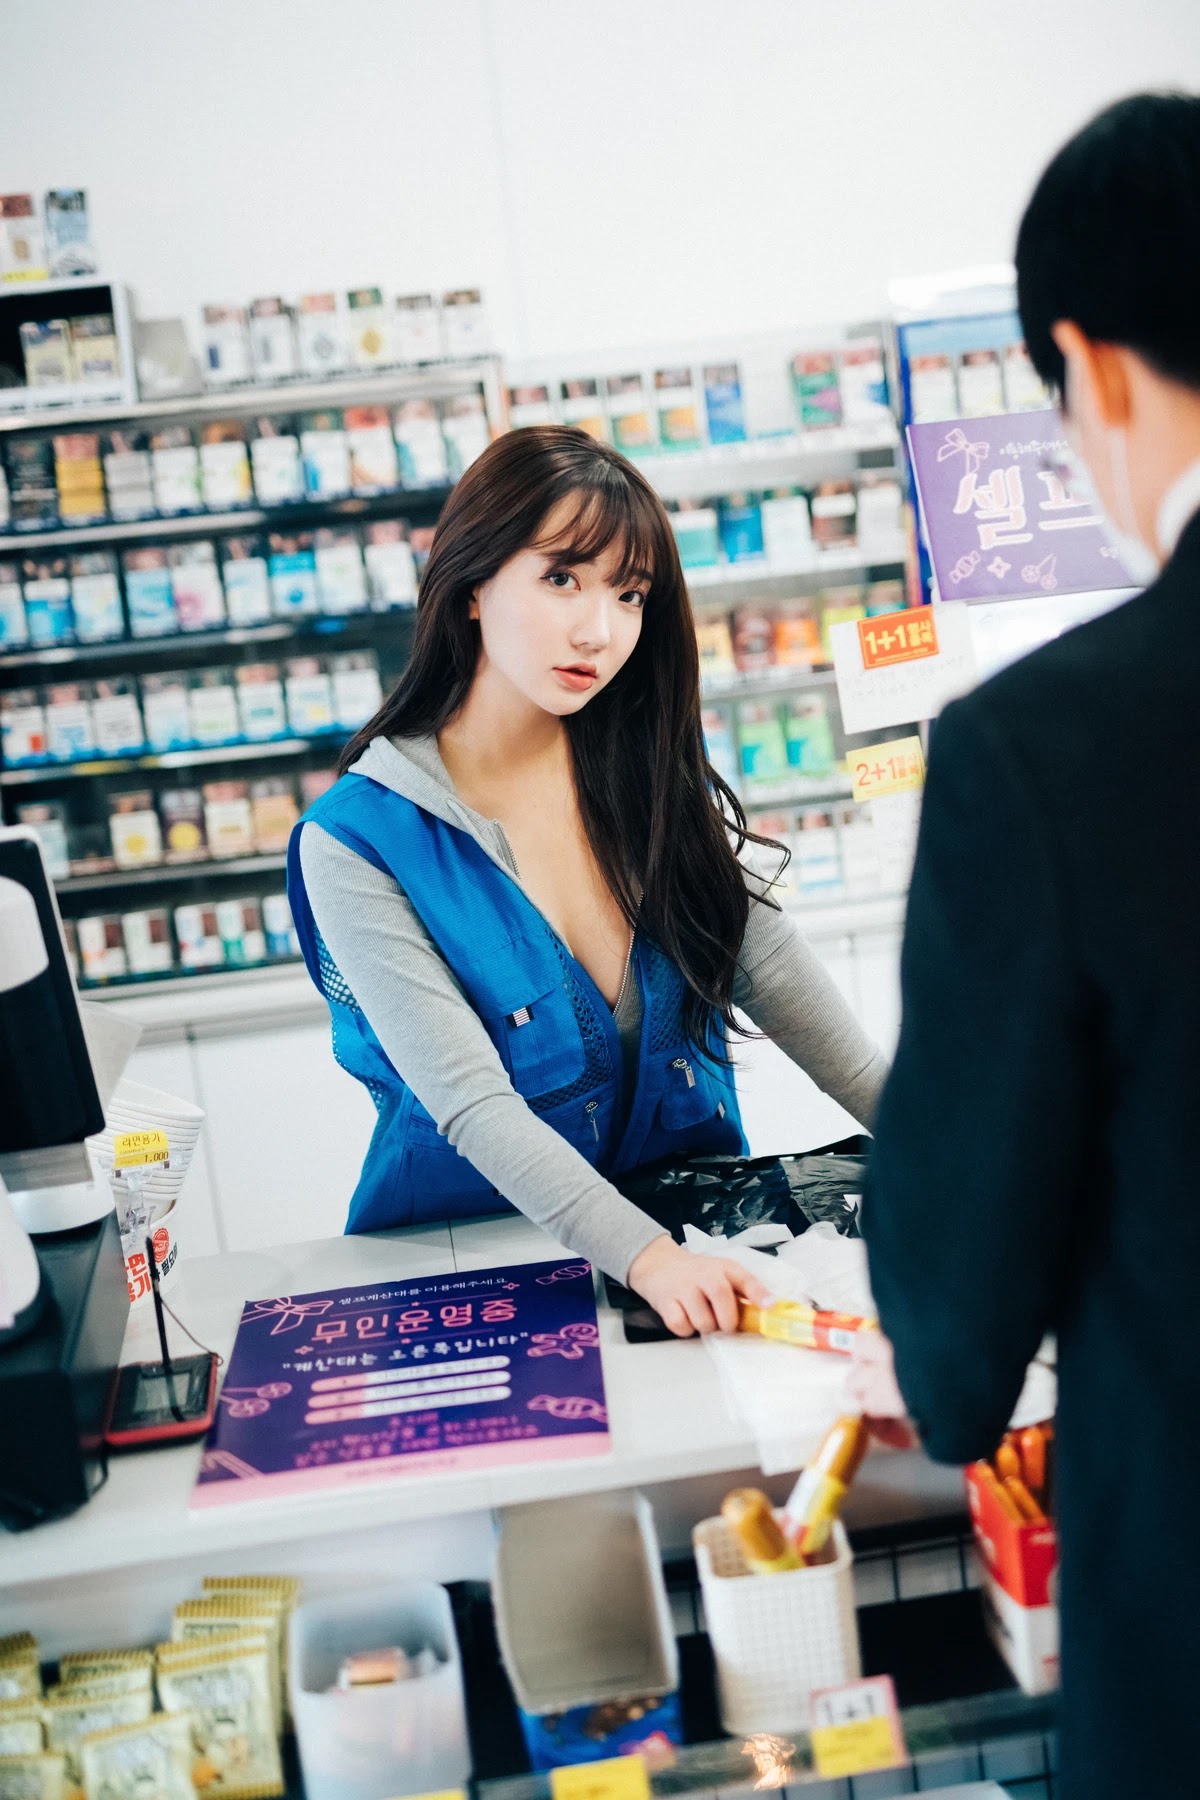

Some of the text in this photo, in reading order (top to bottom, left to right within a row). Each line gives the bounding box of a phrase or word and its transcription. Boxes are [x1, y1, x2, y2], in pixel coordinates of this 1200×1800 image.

[864, 624, 907, 655] 1+1
[856, 757, 896, 786] 2+1
[122, 1132, 160, 1147] 라면용기
[144, 1151, 169, 1163] 1,000
[338, 1277, 507, 1305] 셀프계산대를 이용해주세요
[311, 1298, 517, 1343] 무인운영중
